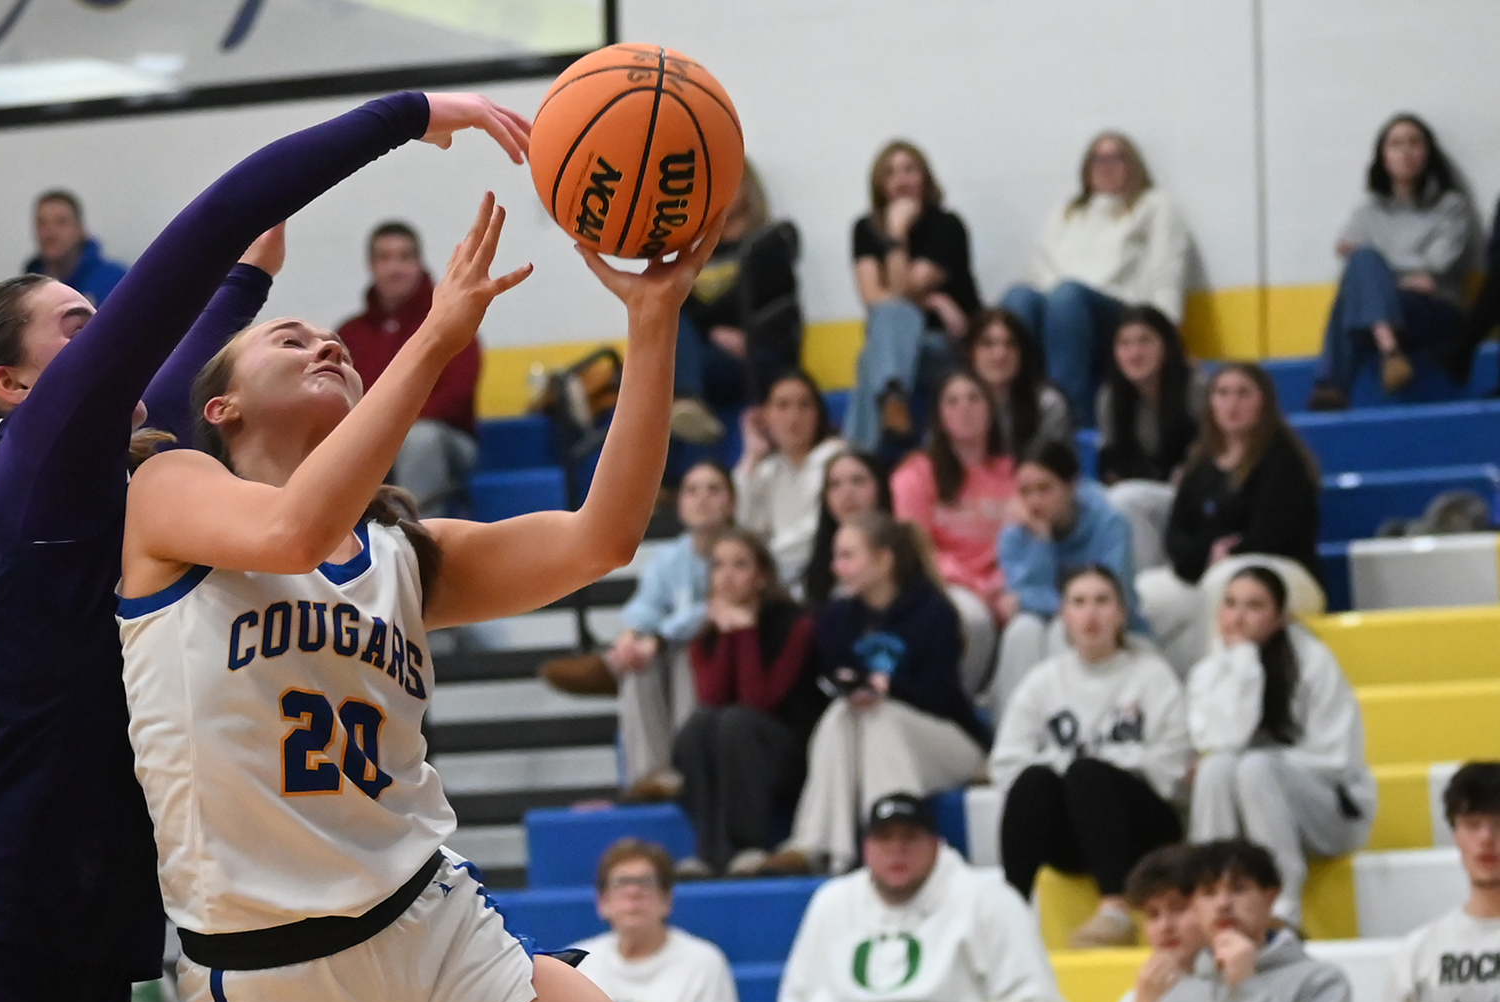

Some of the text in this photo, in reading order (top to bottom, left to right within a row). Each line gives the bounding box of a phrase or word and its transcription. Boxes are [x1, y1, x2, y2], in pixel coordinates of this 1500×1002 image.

[574, 156, 624, 242] NCAA
[227, 600, 427, 701] COUGARS
[279, 686, 395, 801] 20
[1439, 953, 1500, 986] ROC
